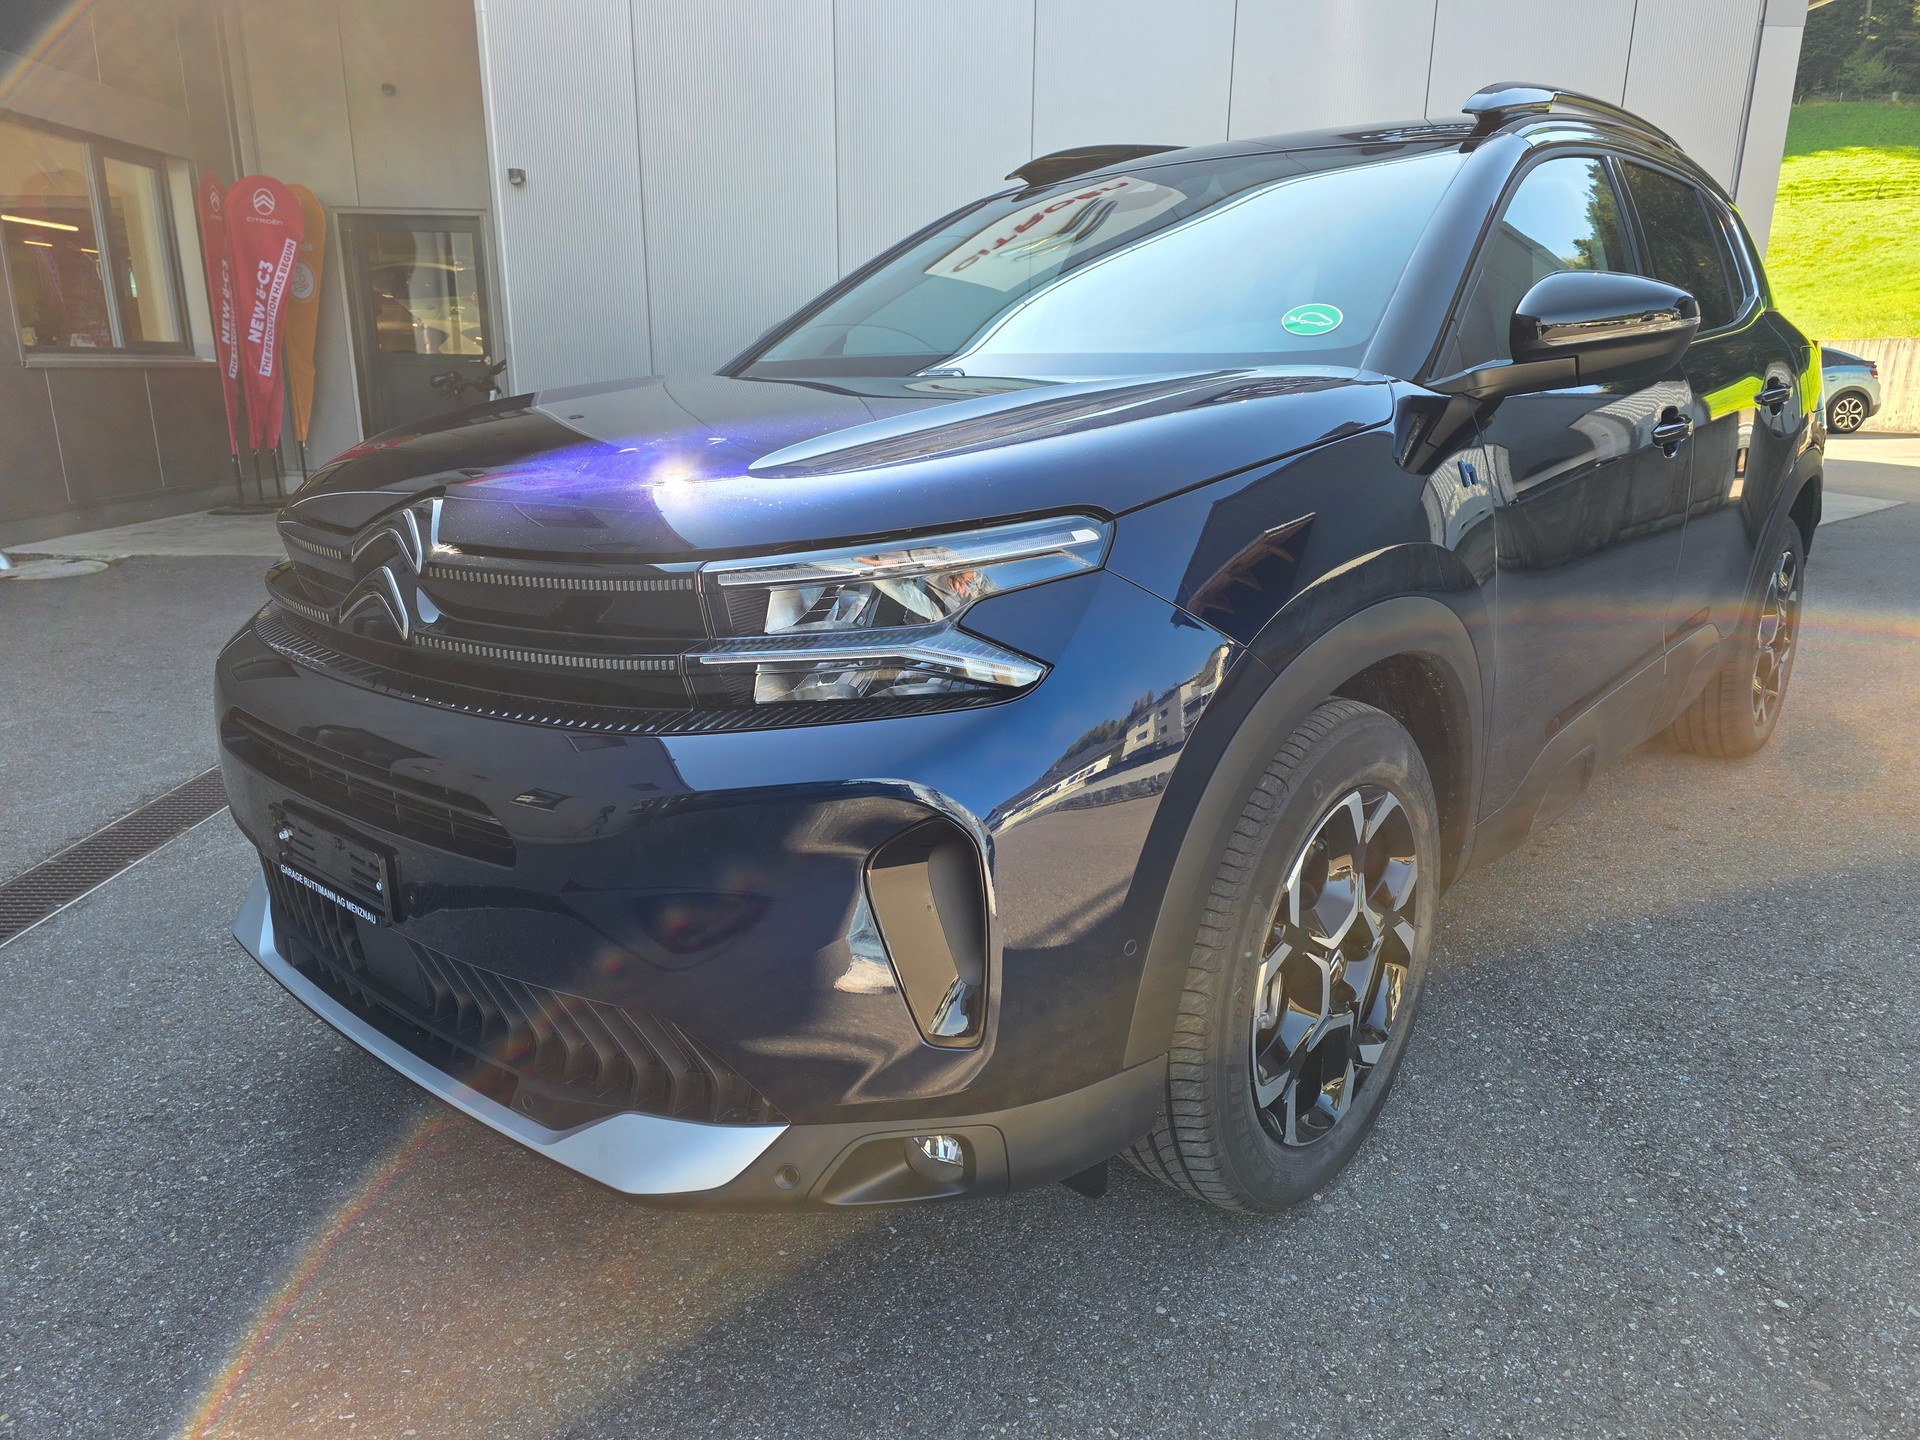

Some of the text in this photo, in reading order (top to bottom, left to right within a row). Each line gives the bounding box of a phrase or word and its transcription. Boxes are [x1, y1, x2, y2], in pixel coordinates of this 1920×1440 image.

[247, 300, 266, 343] NEW
[261, 241, 295, 373] THE REVOLUTION HAS BEGUN
[280, 864, 303, 884] GARAGE
[336, 895, 346, 908] AG
